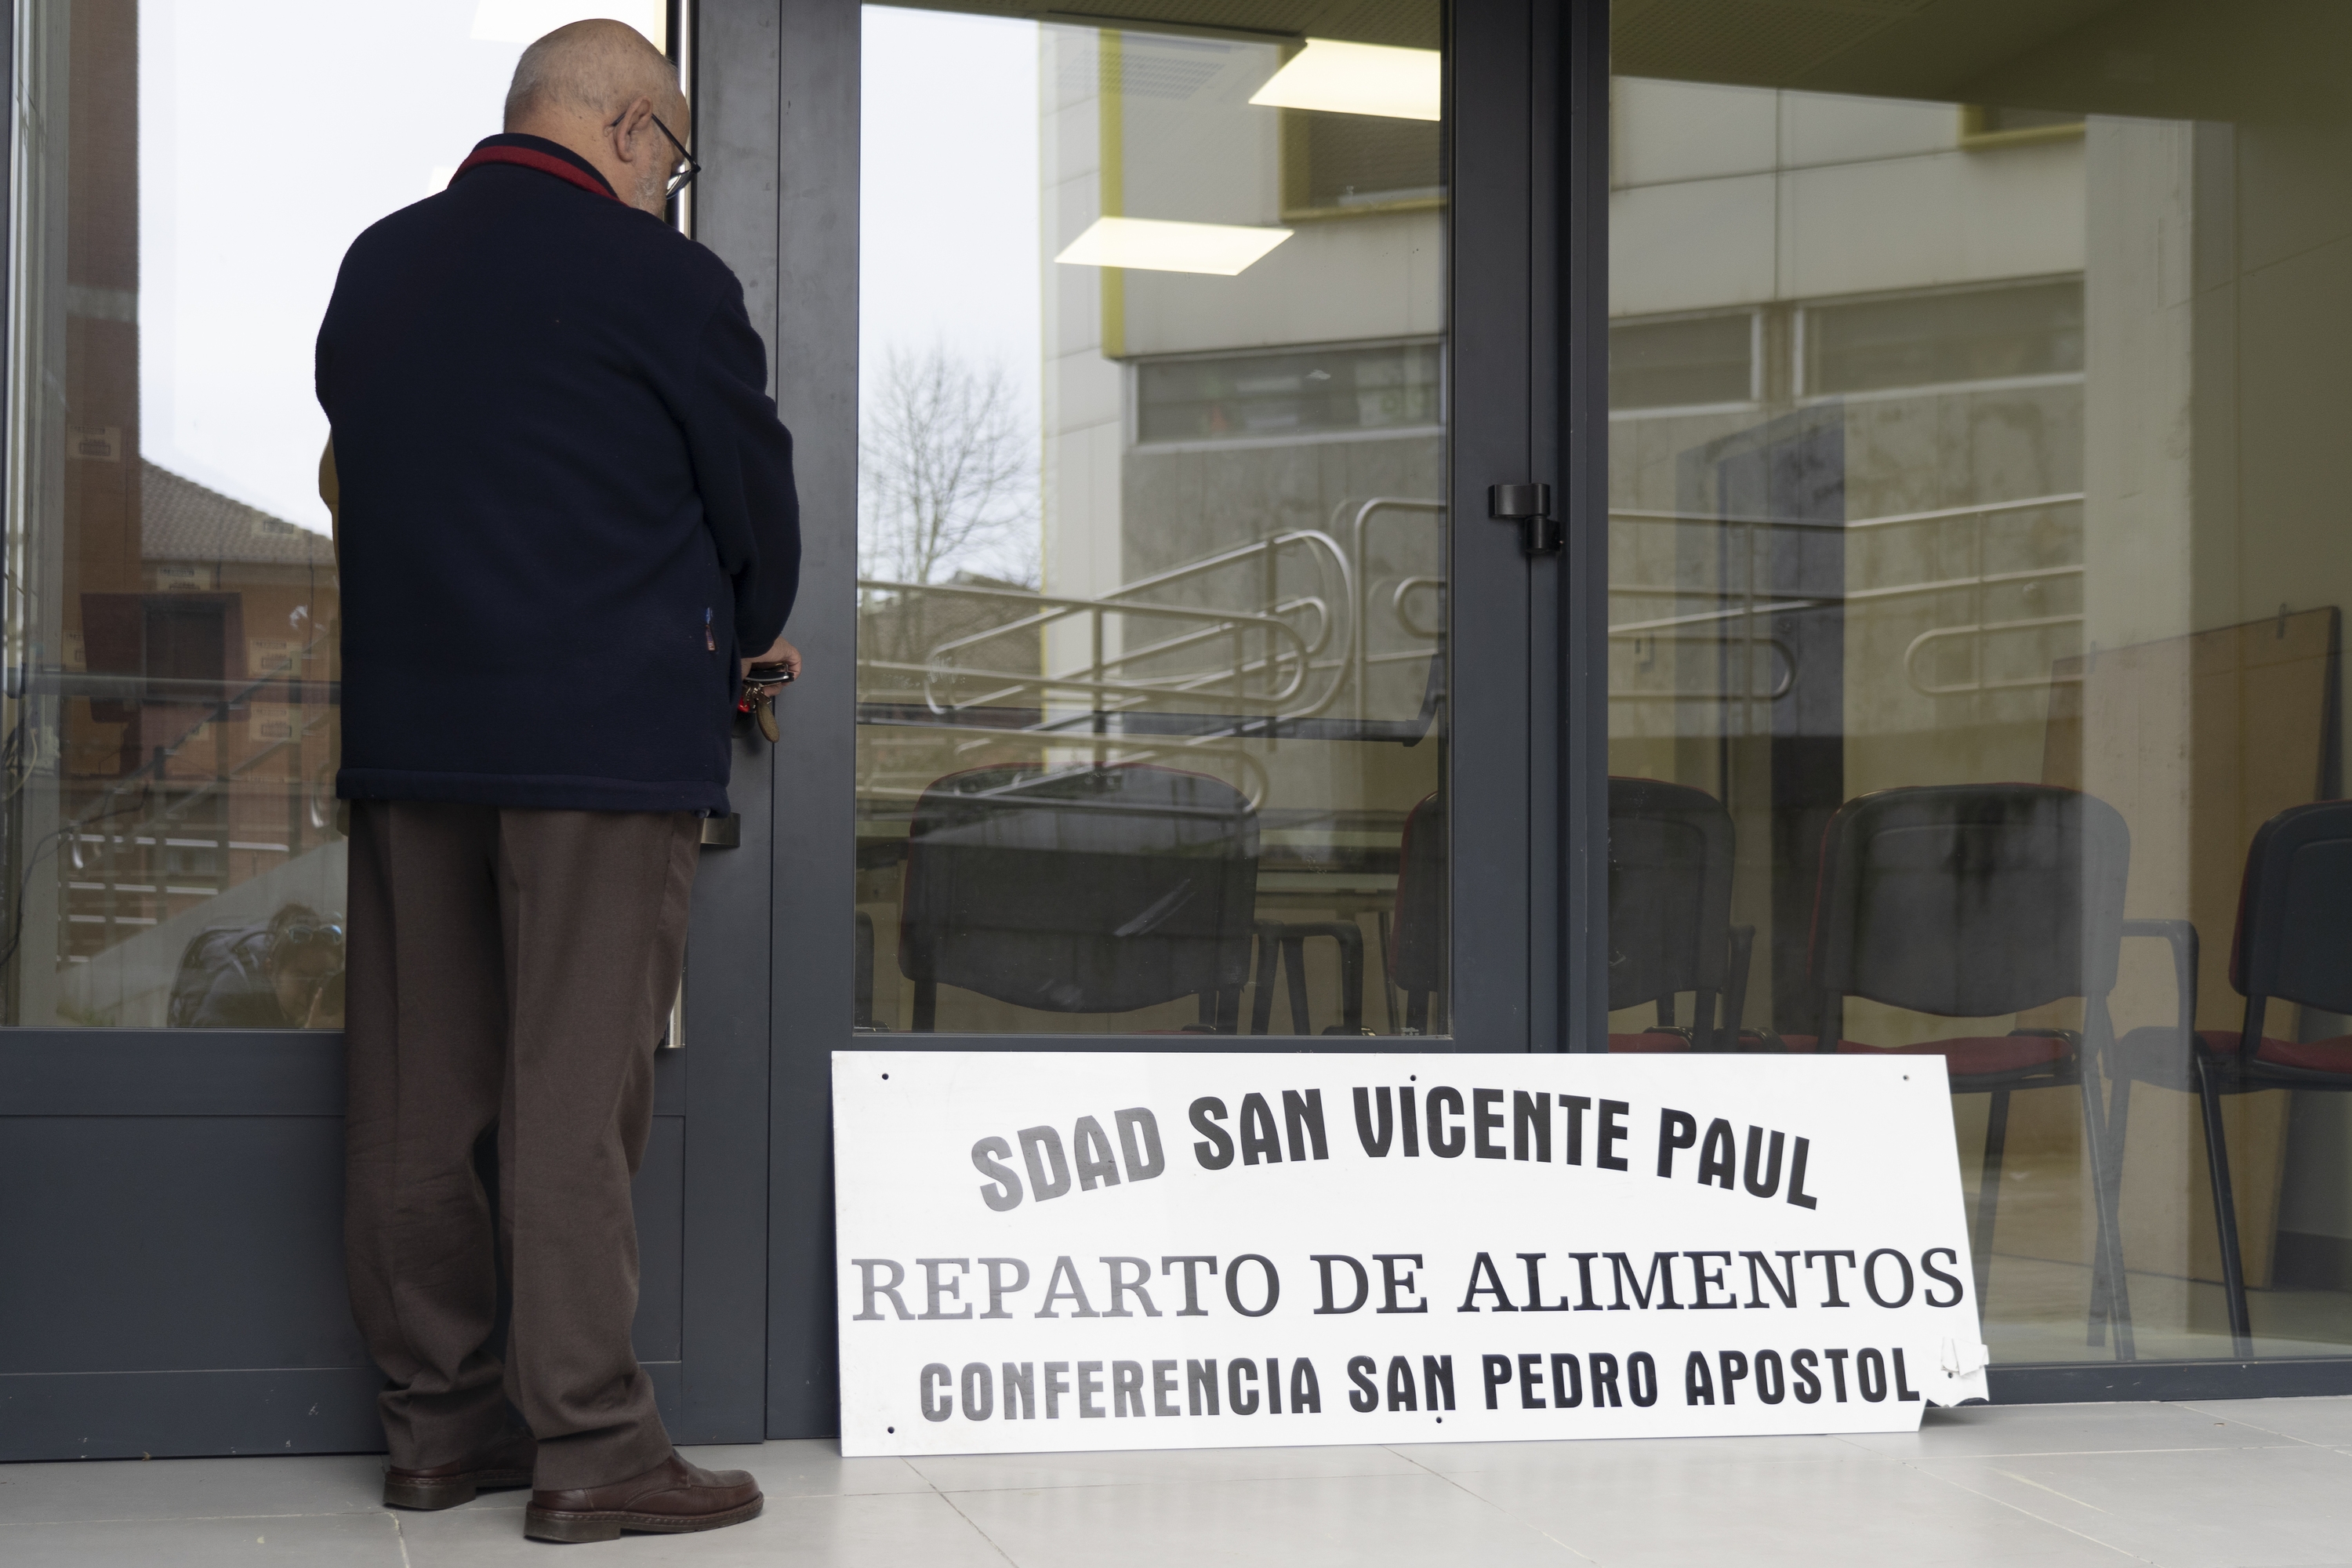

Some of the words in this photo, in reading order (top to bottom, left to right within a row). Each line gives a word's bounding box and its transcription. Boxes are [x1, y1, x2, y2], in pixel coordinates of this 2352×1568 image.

[971, 1107, 1165, 1212] SDAD
[1188, 1088, 1330, 1171] SAN
[1352, 1086, 1630, 1172] VICENTE
[1657, 1107, 1817, 1210] PAUL
[851, 1253, 1280, 1321] REPARTO
[1309, 1253, 1428, 1315] DE
[1457, 1247, 1964, 1313] ALIMENTOS
[920, 1356, 1322, 1422] CONFERENCIA
[1347, 1354, 1457, 1414] SAN
[1482, 1351, 1658, 1410] PEDRO
[1685, 1347, 1921, 1406] APOSTOL
